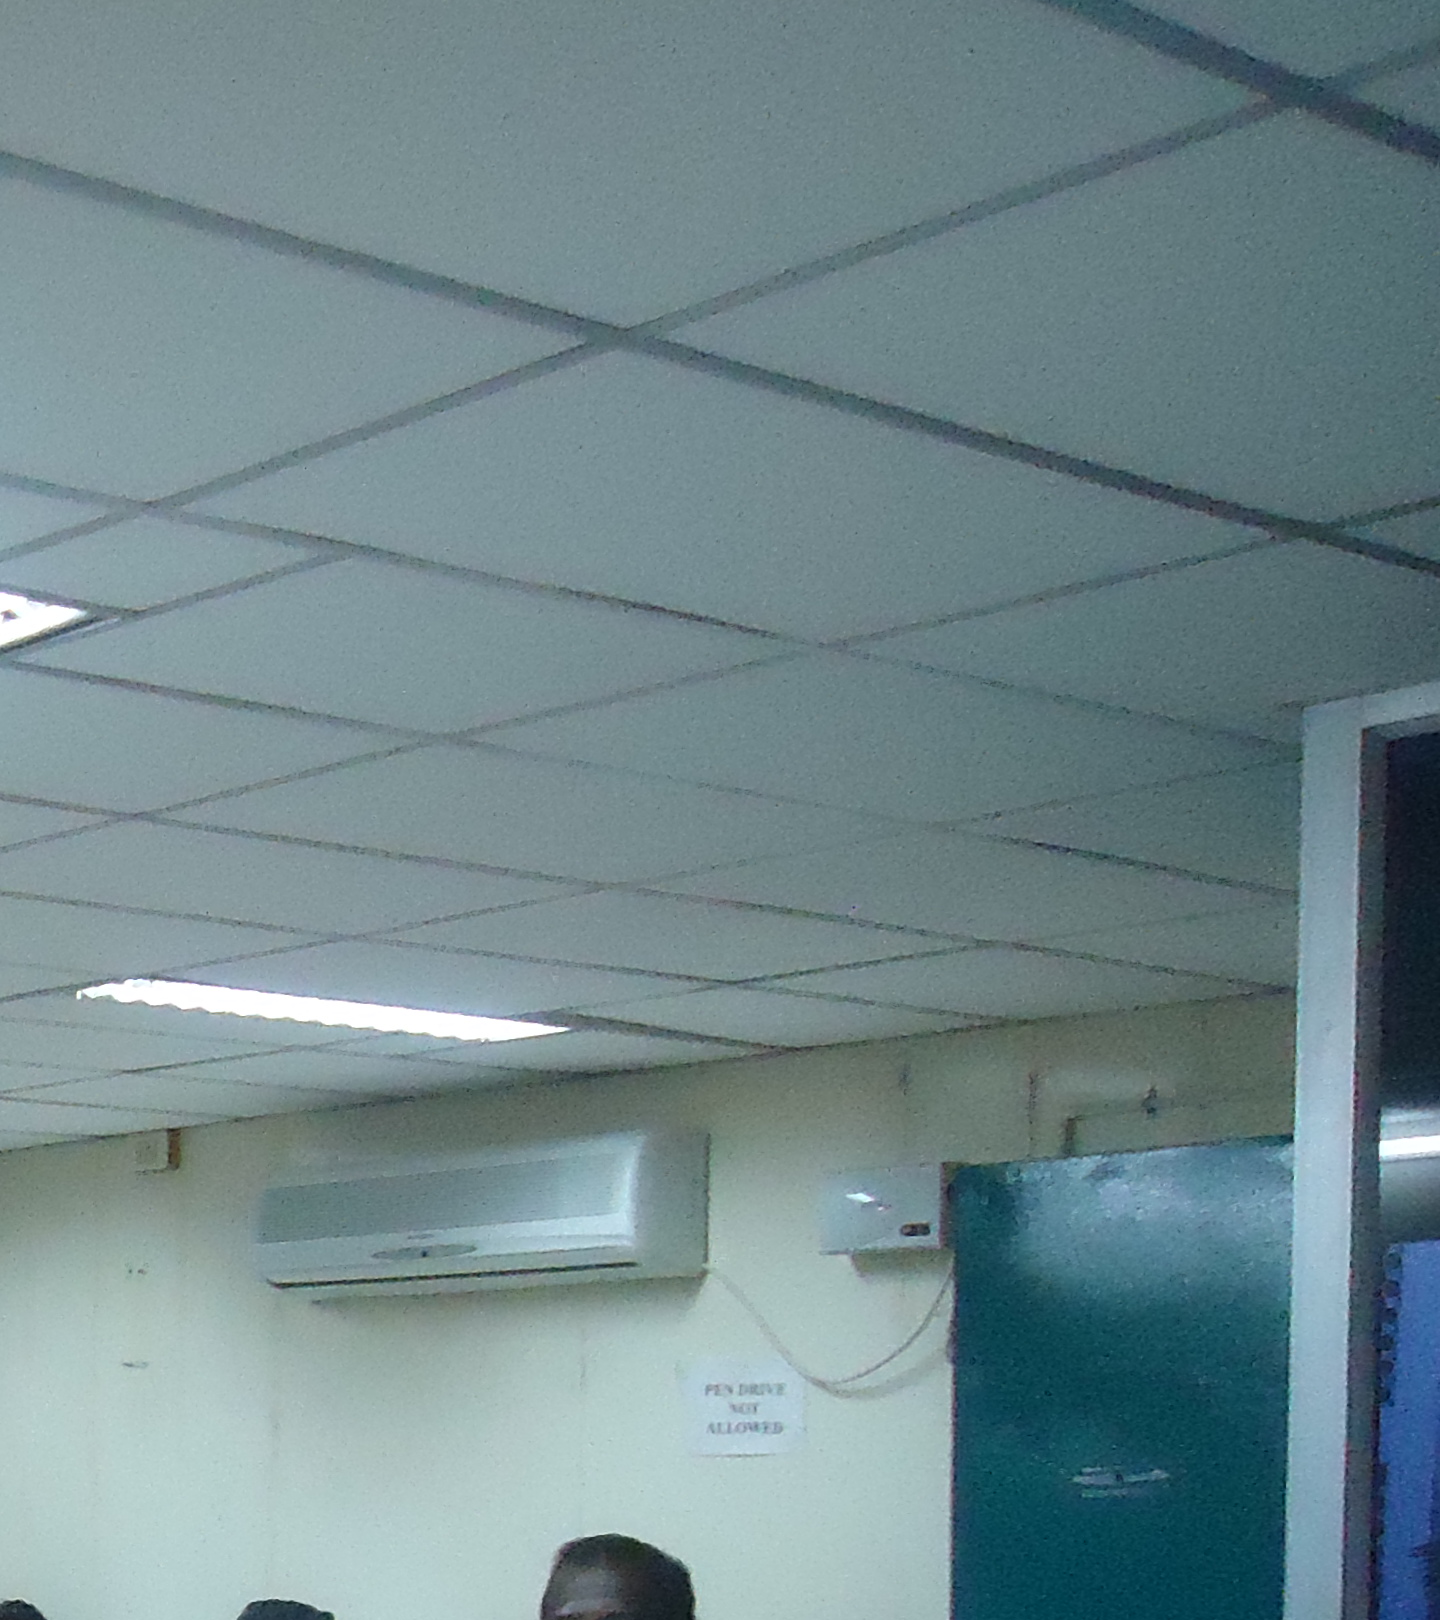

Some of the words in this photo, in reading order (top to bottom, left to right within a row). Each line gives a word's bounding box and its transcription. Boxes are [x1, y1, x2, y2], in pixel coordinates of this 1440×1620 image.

[705, 1383, 734, 1396] PEN
[738, 1382, 787, 1396] DRIVE
[729, 1402, 759, 1415] NOT
[706, 1421, 784, 1435] ALLOWED
